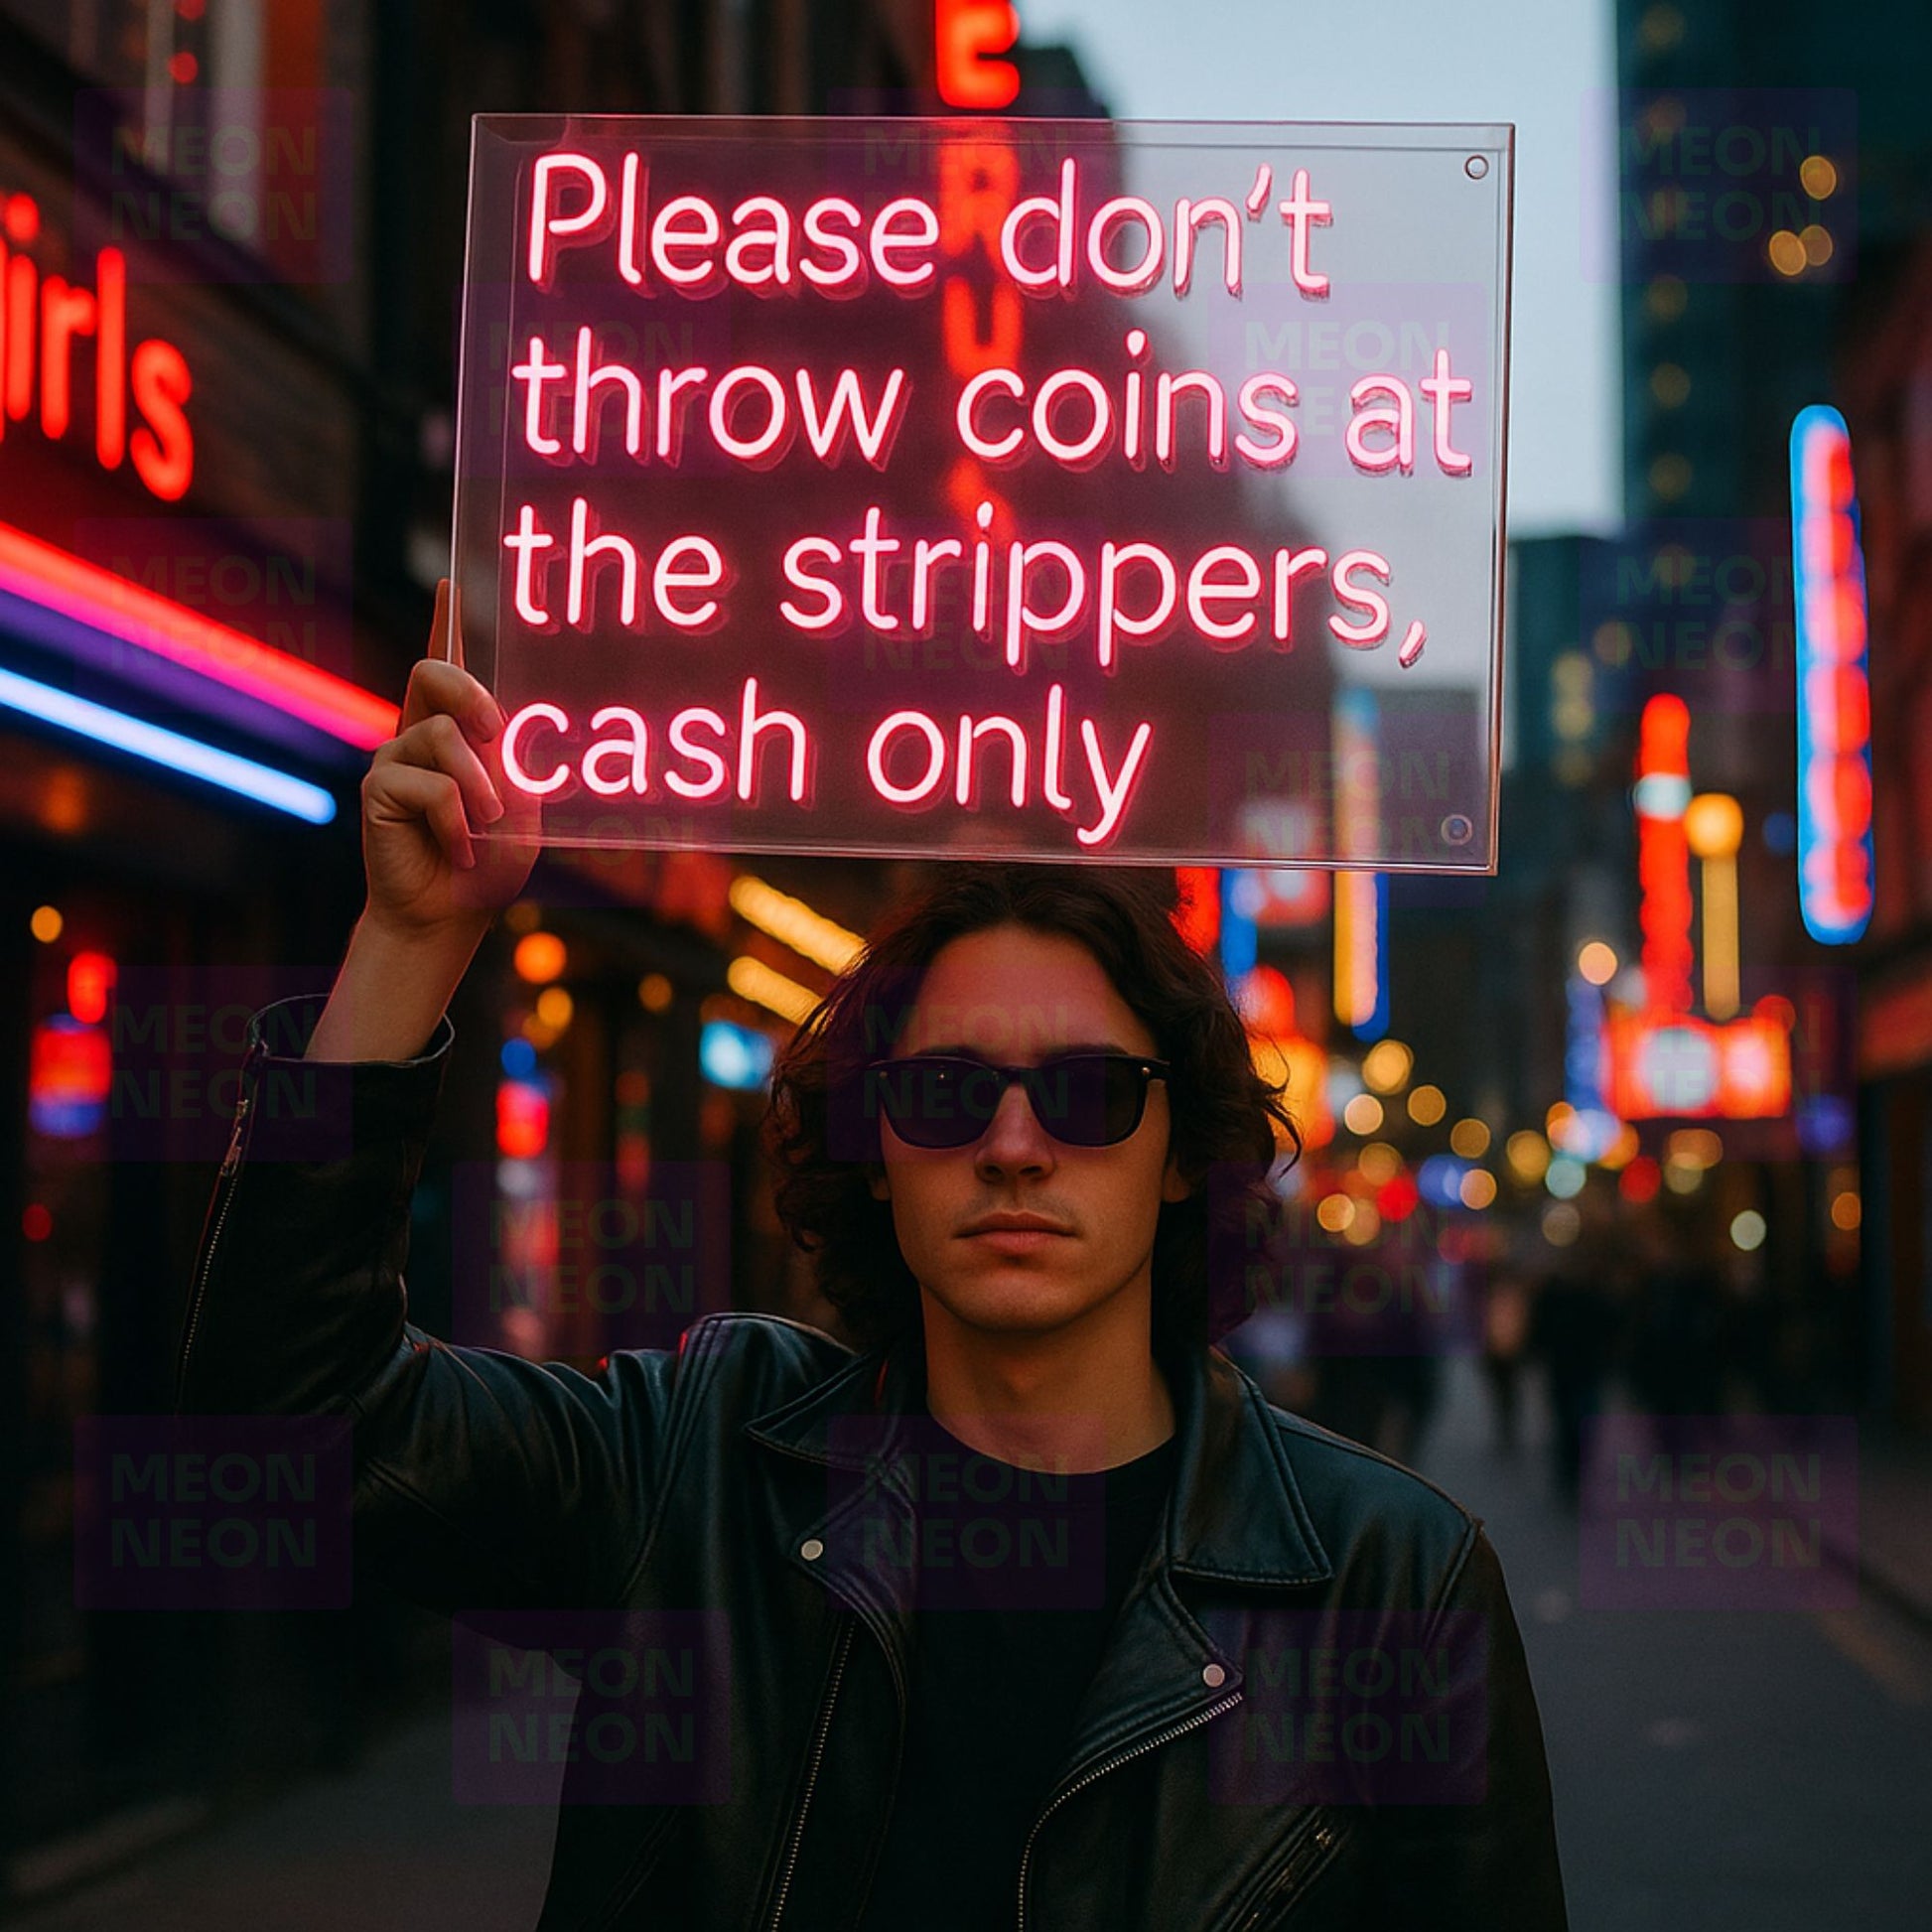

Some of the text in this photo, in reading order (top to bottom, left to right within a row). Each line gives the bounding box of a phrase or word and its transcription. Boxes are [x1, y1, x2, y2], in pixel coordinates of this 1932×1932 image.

[526, 152, 940, 286] Please
[0, 191, 195, 502] irls
[510, 326, 1473, 475] throw coins at
[501, 497, 1427, 667] the strippers,
[499, 677, 1153, 845] cash only
